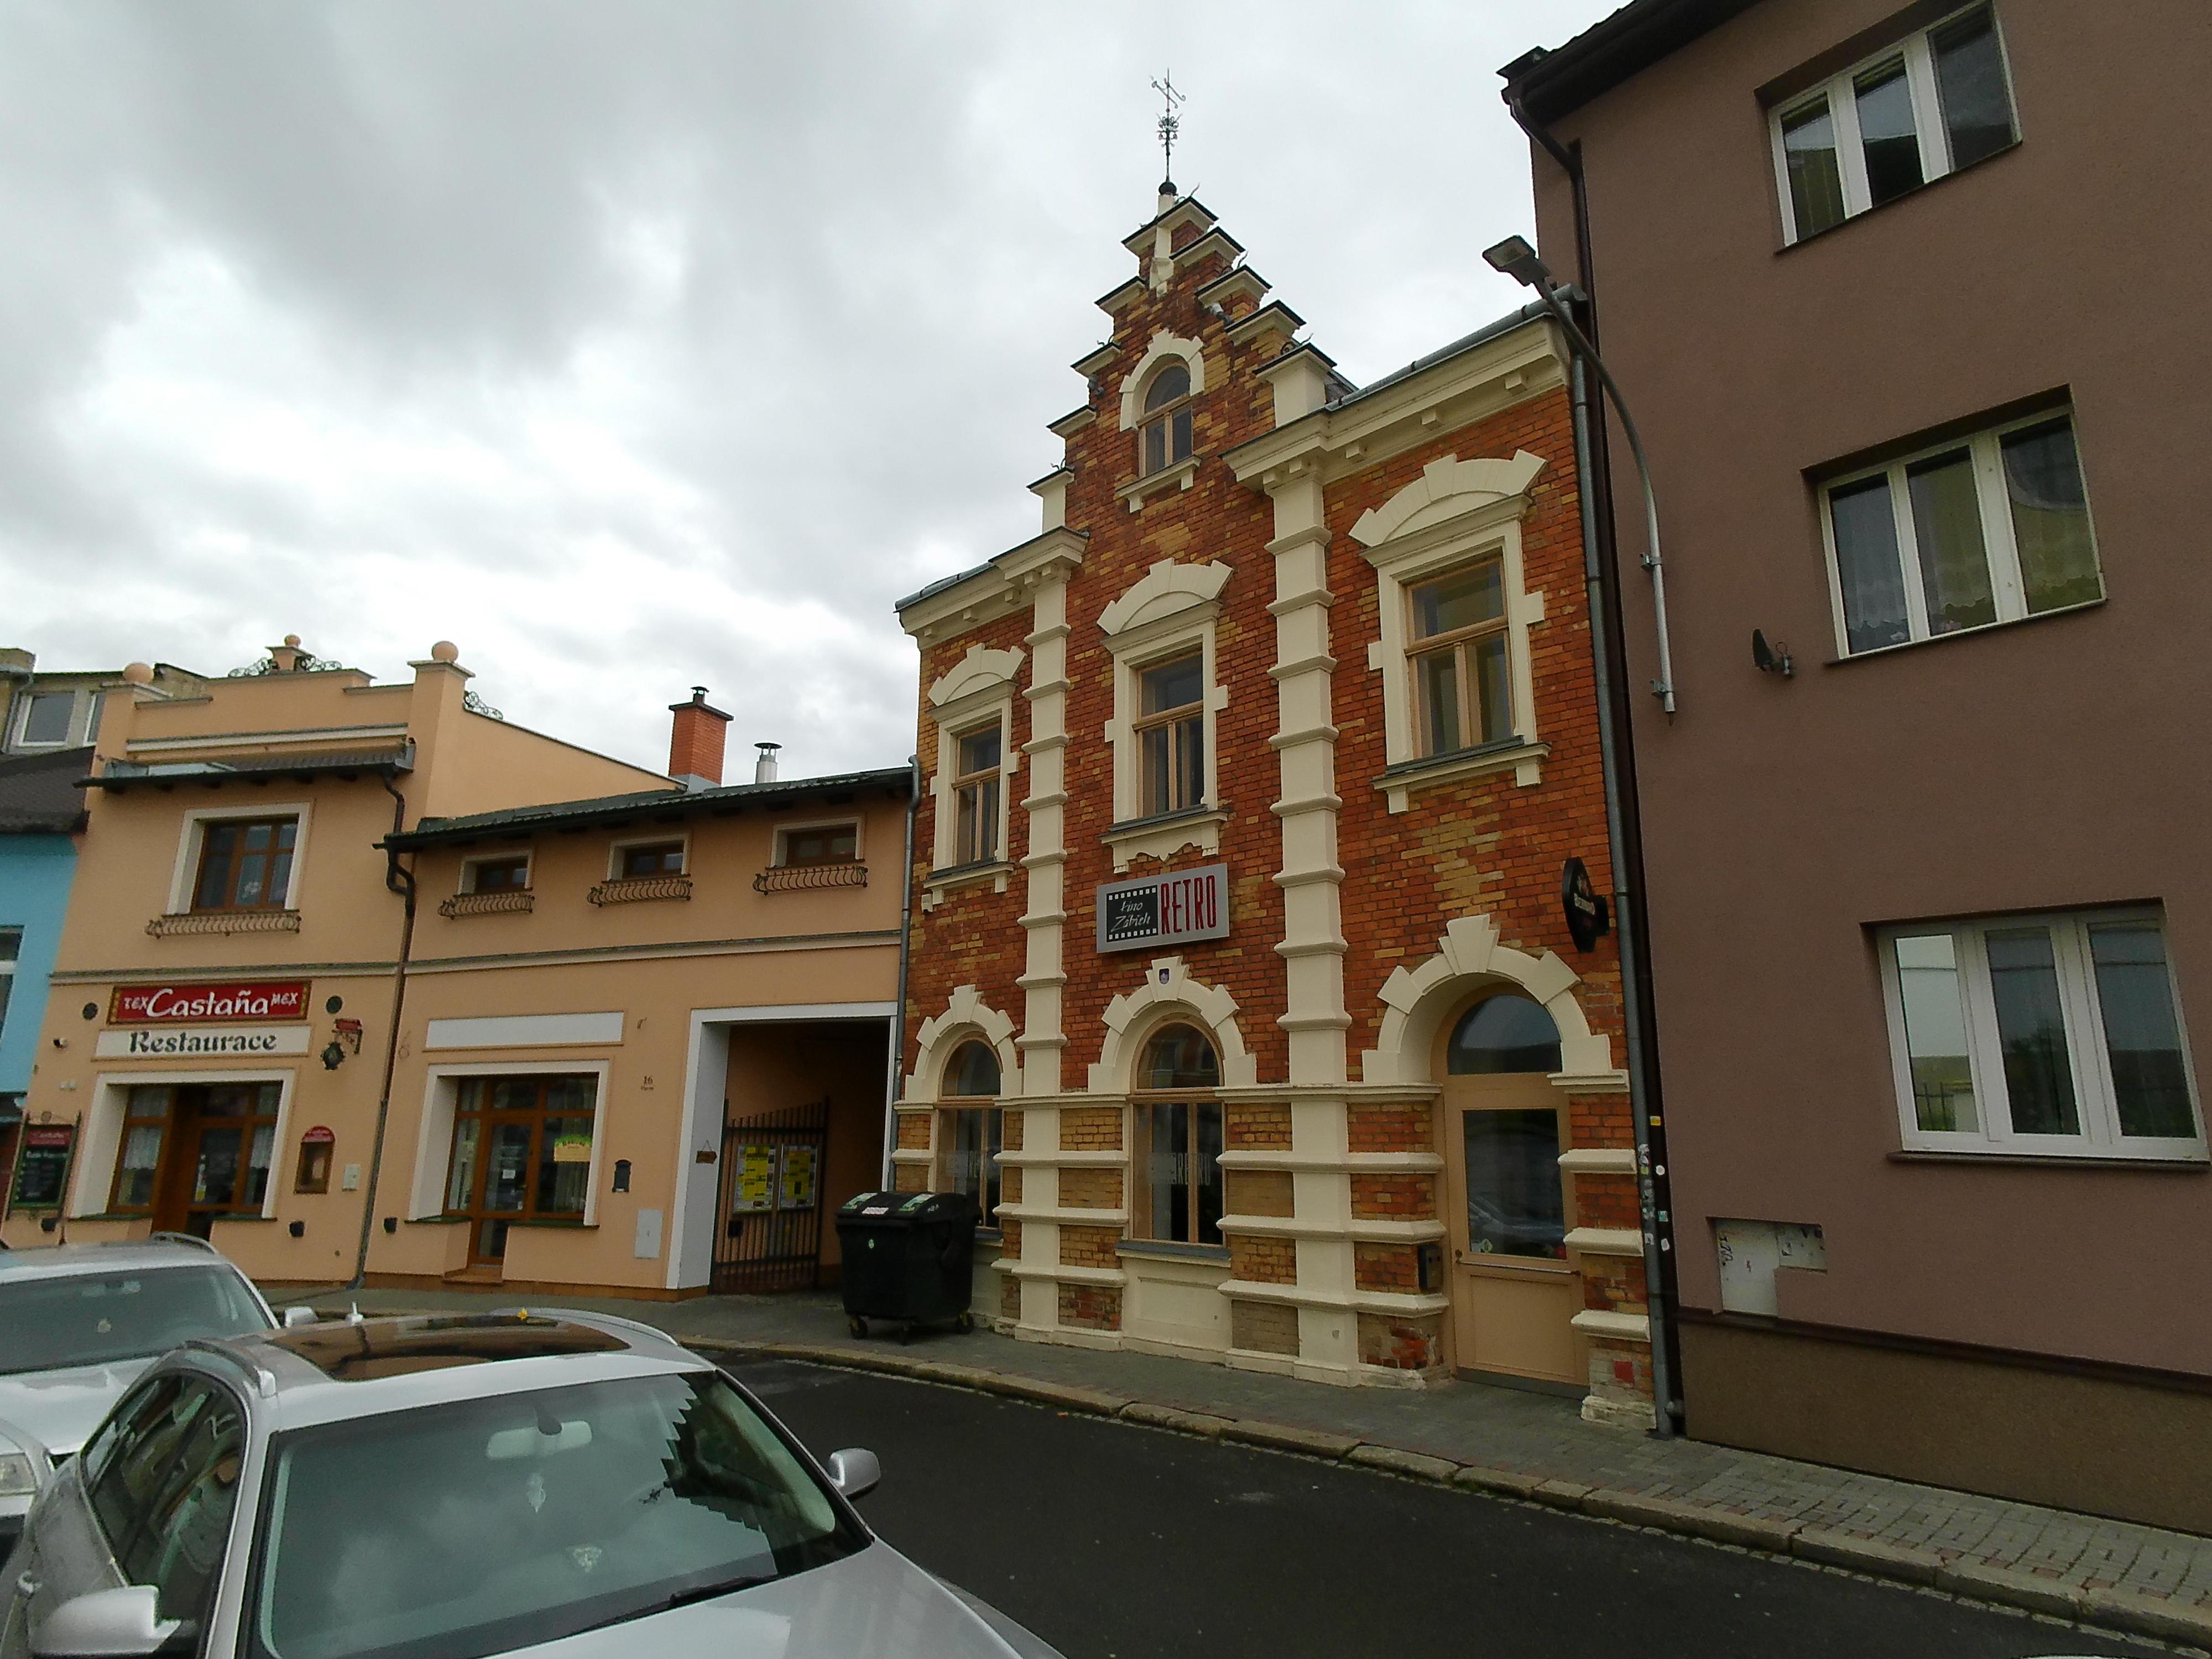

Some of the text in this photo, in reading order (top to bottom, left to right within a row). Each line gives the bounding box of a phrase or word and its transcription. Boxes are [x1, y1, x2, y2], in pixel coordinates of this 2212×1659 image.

[1160, 875, 1217, 935] RETRO
[124, 988, 299, 1017] TEX Castaña MEX
[129, 1031, 277, 1053] Restaurace
[1178, 1152, 1210, 1185] RERO
